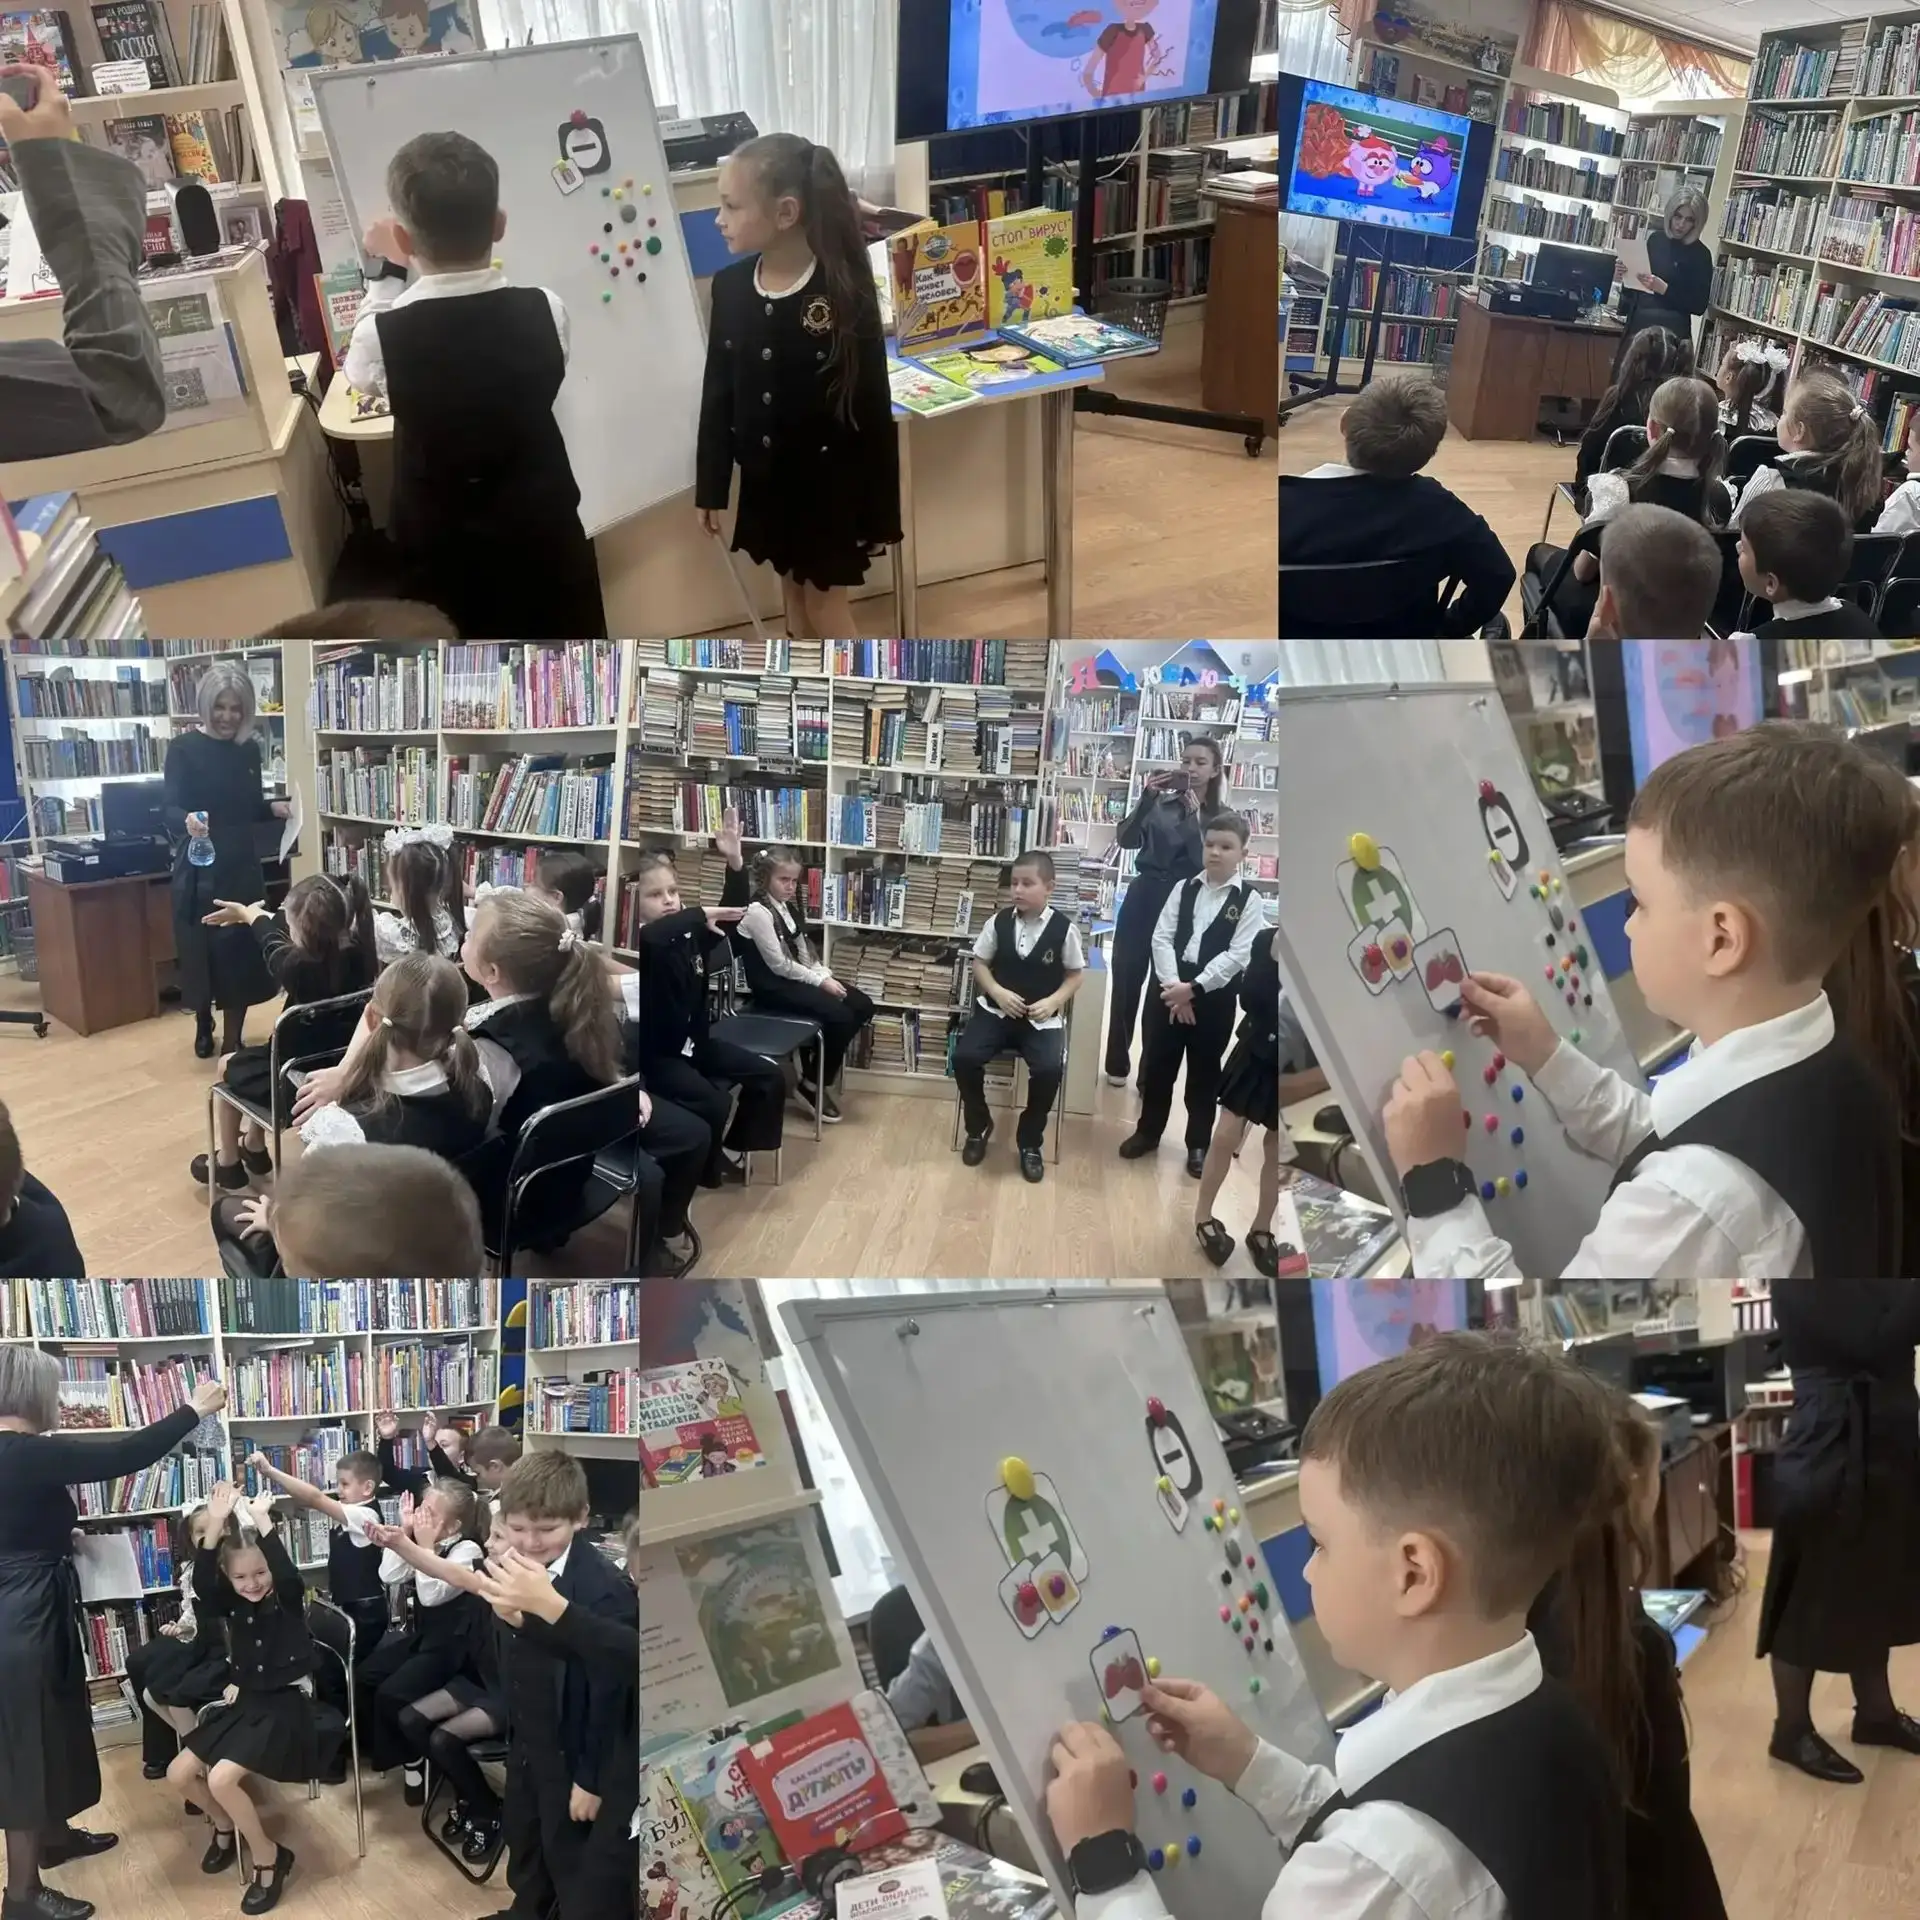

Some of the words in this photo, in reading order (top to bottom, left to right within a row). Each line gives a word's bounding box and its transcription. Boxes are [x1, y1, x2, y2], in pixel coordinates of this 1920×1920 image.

[111, 34, 159, 60] ОССИЯ
[992, 230, 1024, 247] СТОП
[1029, 219, 1067, 238] ВИРУС!
[916, 273, 934, 283] Как
[865, 818, 874, 842] Гусев
[850, 1897, 878, 1912] ДЕТИ
[882, 1886, 926, 1903] ОНЛАЙН
